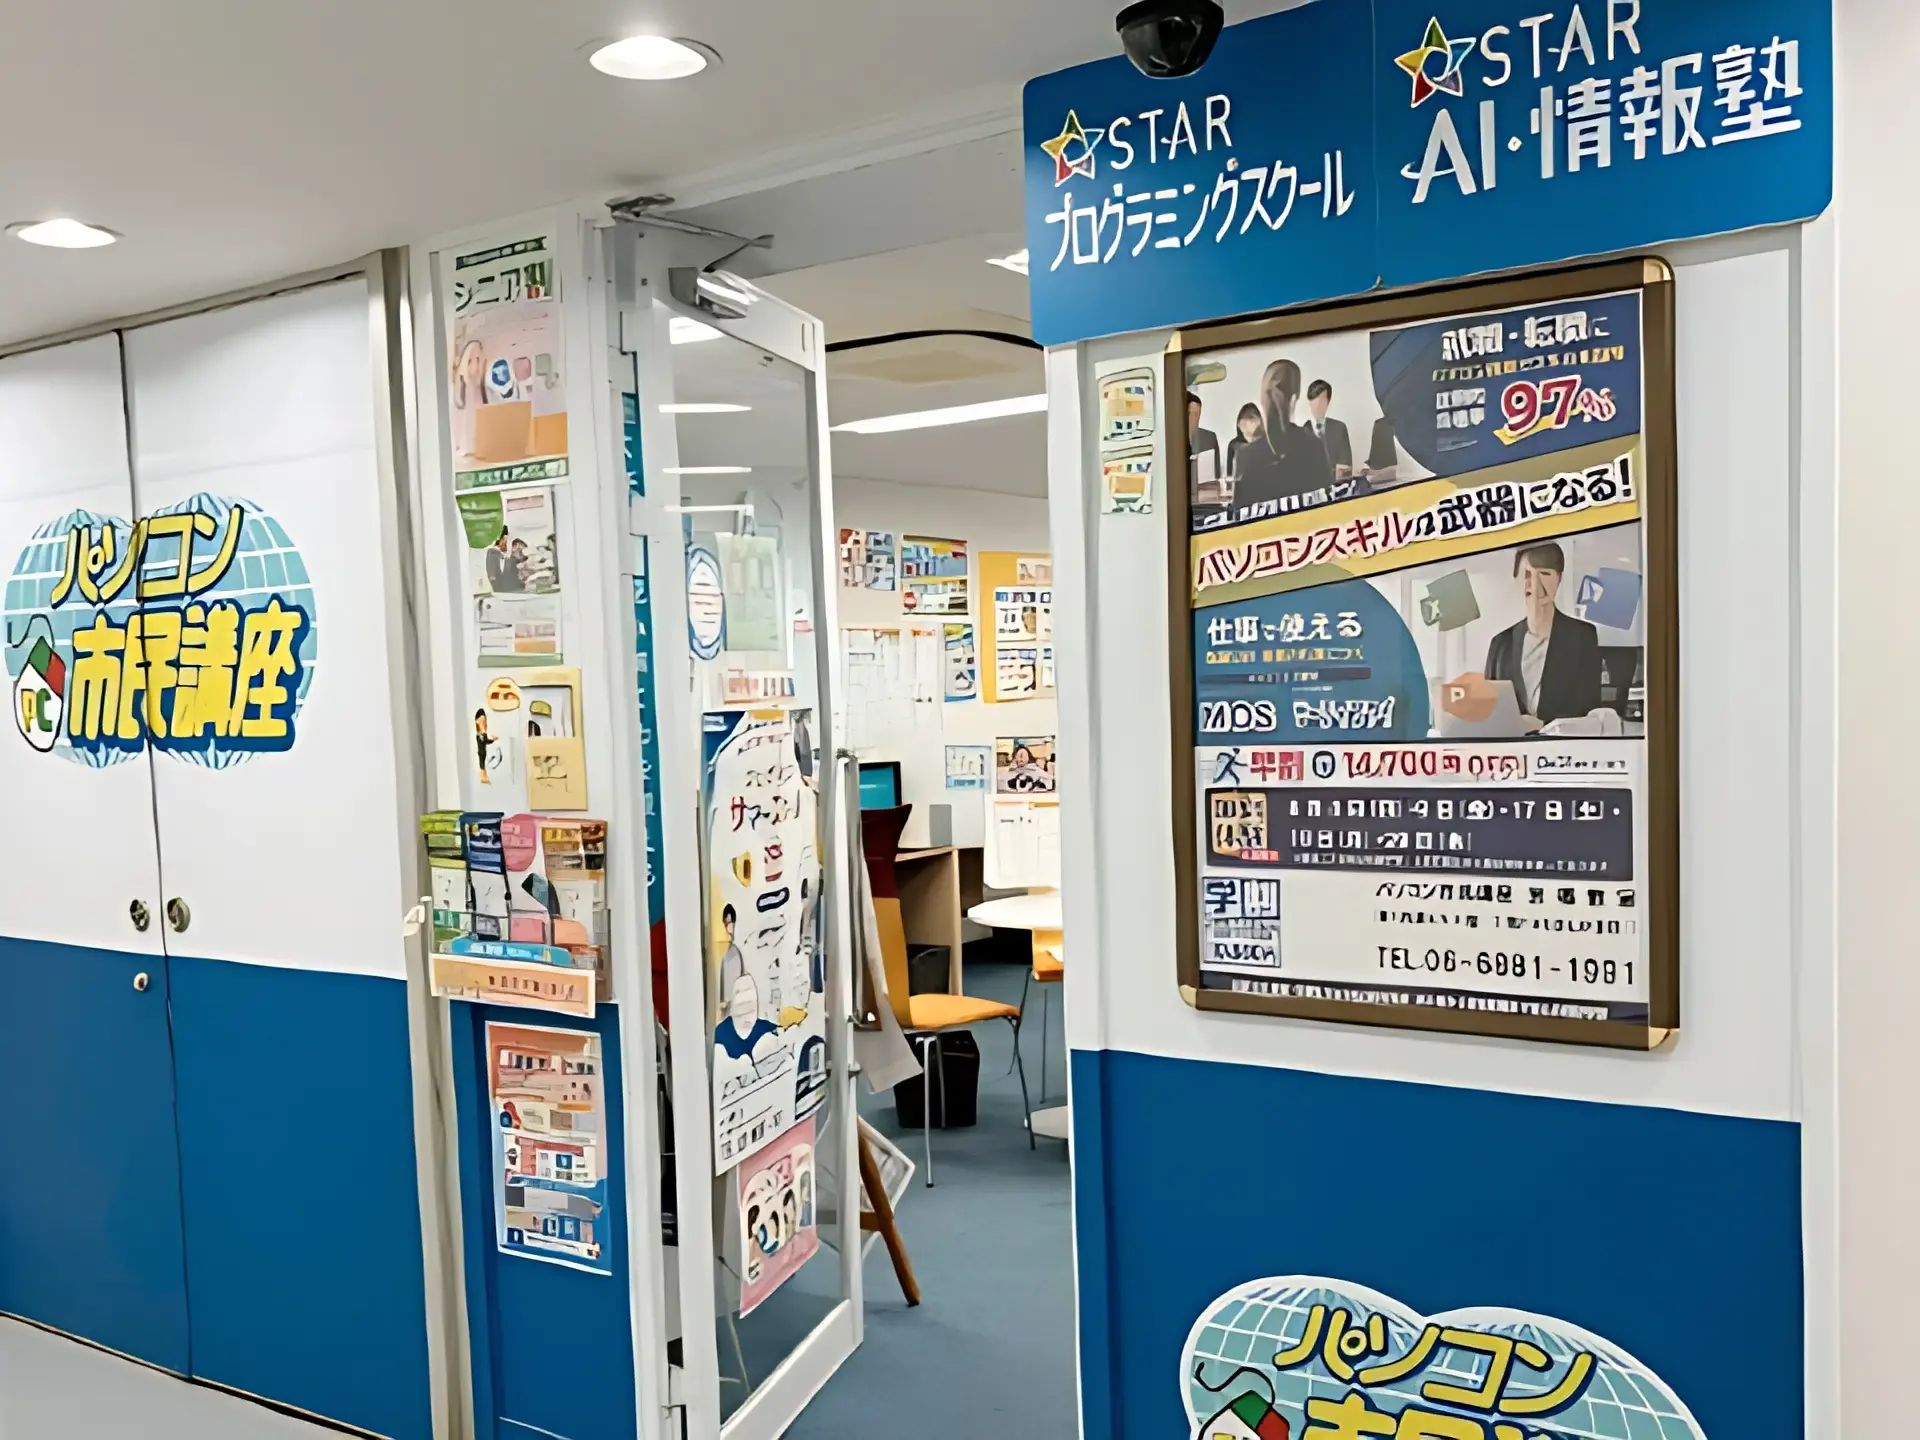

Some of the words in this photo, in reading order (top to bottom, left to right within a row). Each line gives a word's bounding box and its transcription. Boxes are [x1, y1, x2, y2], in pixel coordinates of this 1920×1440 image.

[1480, 0, 1641, 87] STAR
[1109, 94, 1233, 170] STAR
[1045, 150, 1355, 272] プログラミングスクール
[51, 504, 243, 608] パソコン
[70, 597, 303, 741] 市民講座
[1274, 1304, 1597, 1414] パソコン
